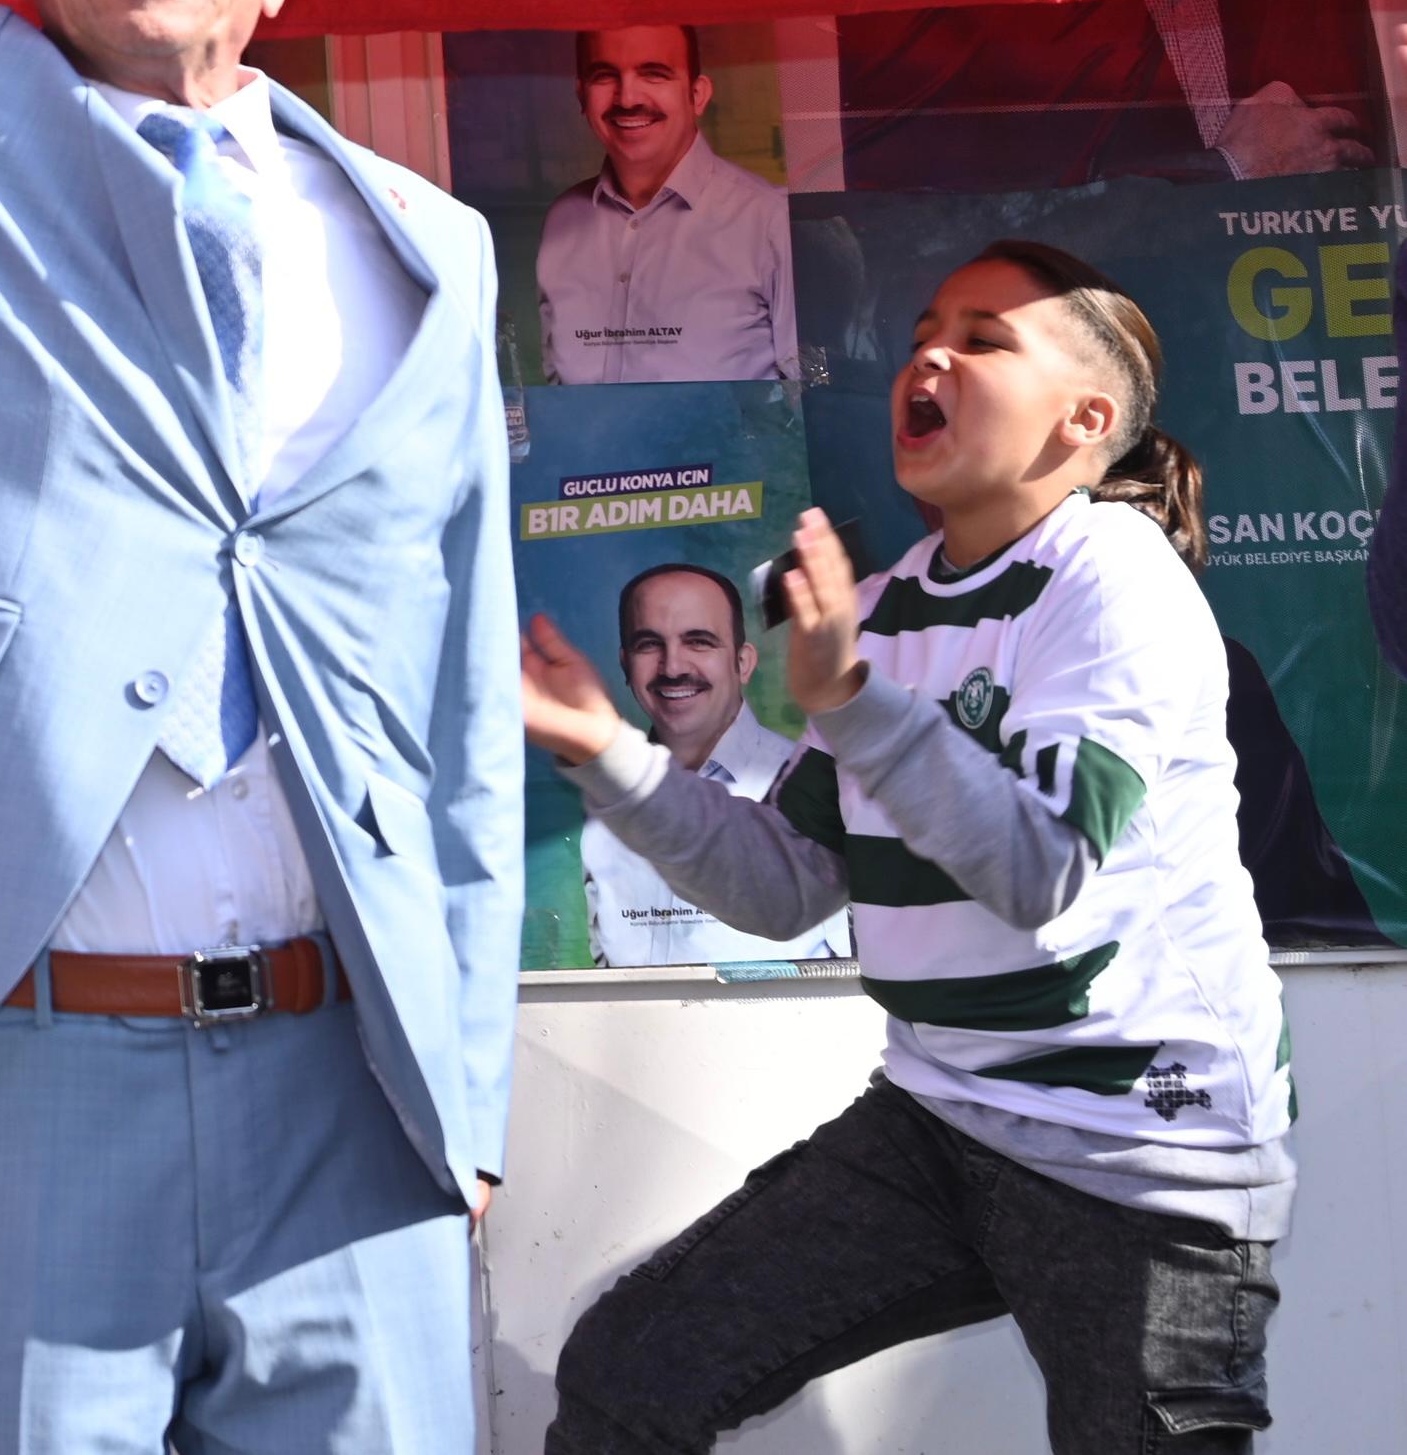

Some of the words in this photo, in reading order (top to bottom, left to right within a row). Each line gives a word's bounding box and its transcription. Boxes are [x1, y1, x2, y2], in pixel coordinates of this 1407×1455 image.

[1227, 241, 1394, 342] GE
[575, 328, 603, 340] Uğur
[648, 327, 683, 337] ALTAY
[1233, 355, 1400, 415] BELE
[620, 472, 675, 491] KONYA
[584, 496, 662, 530] ADIM
[668, 488, 754, 521] DAHA
[1208, 513, 1286, 544] SAN
[621, 909, 648, 920] Uğur
